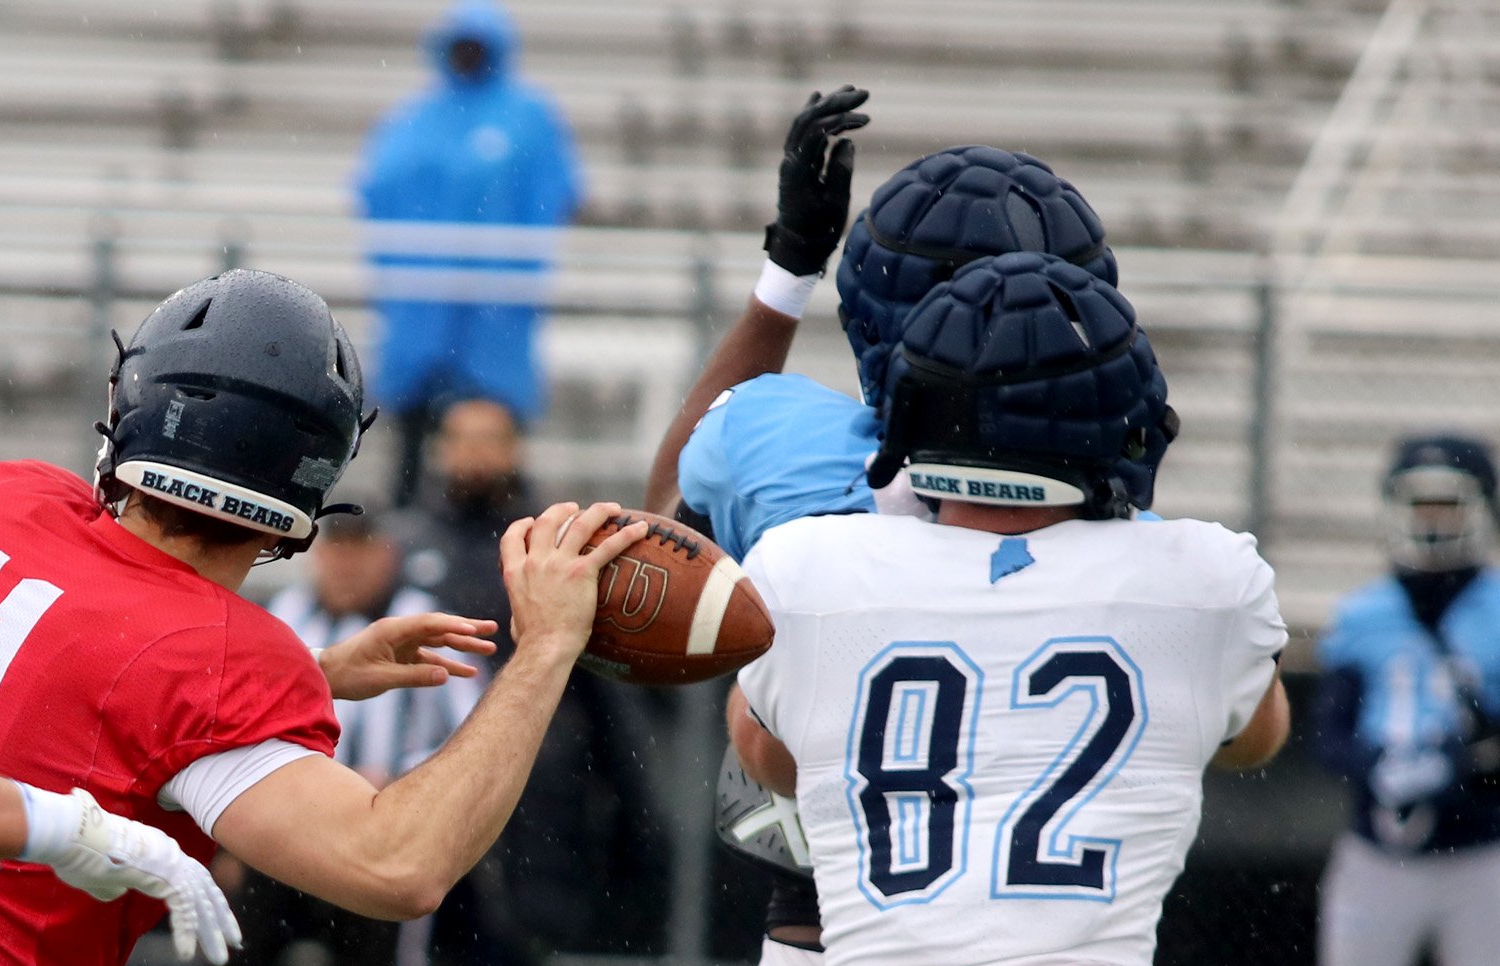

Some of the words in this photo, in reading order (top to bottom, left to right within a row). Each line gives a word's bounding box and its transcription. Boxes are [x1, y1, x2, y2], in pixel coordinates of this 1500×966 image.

[140, 470, 218, 509] BLACK
[220, 494, 294, 532] BEARS
[967, 480, 1045, 501] BEARS
[843, 635, 1149, 912] 82
